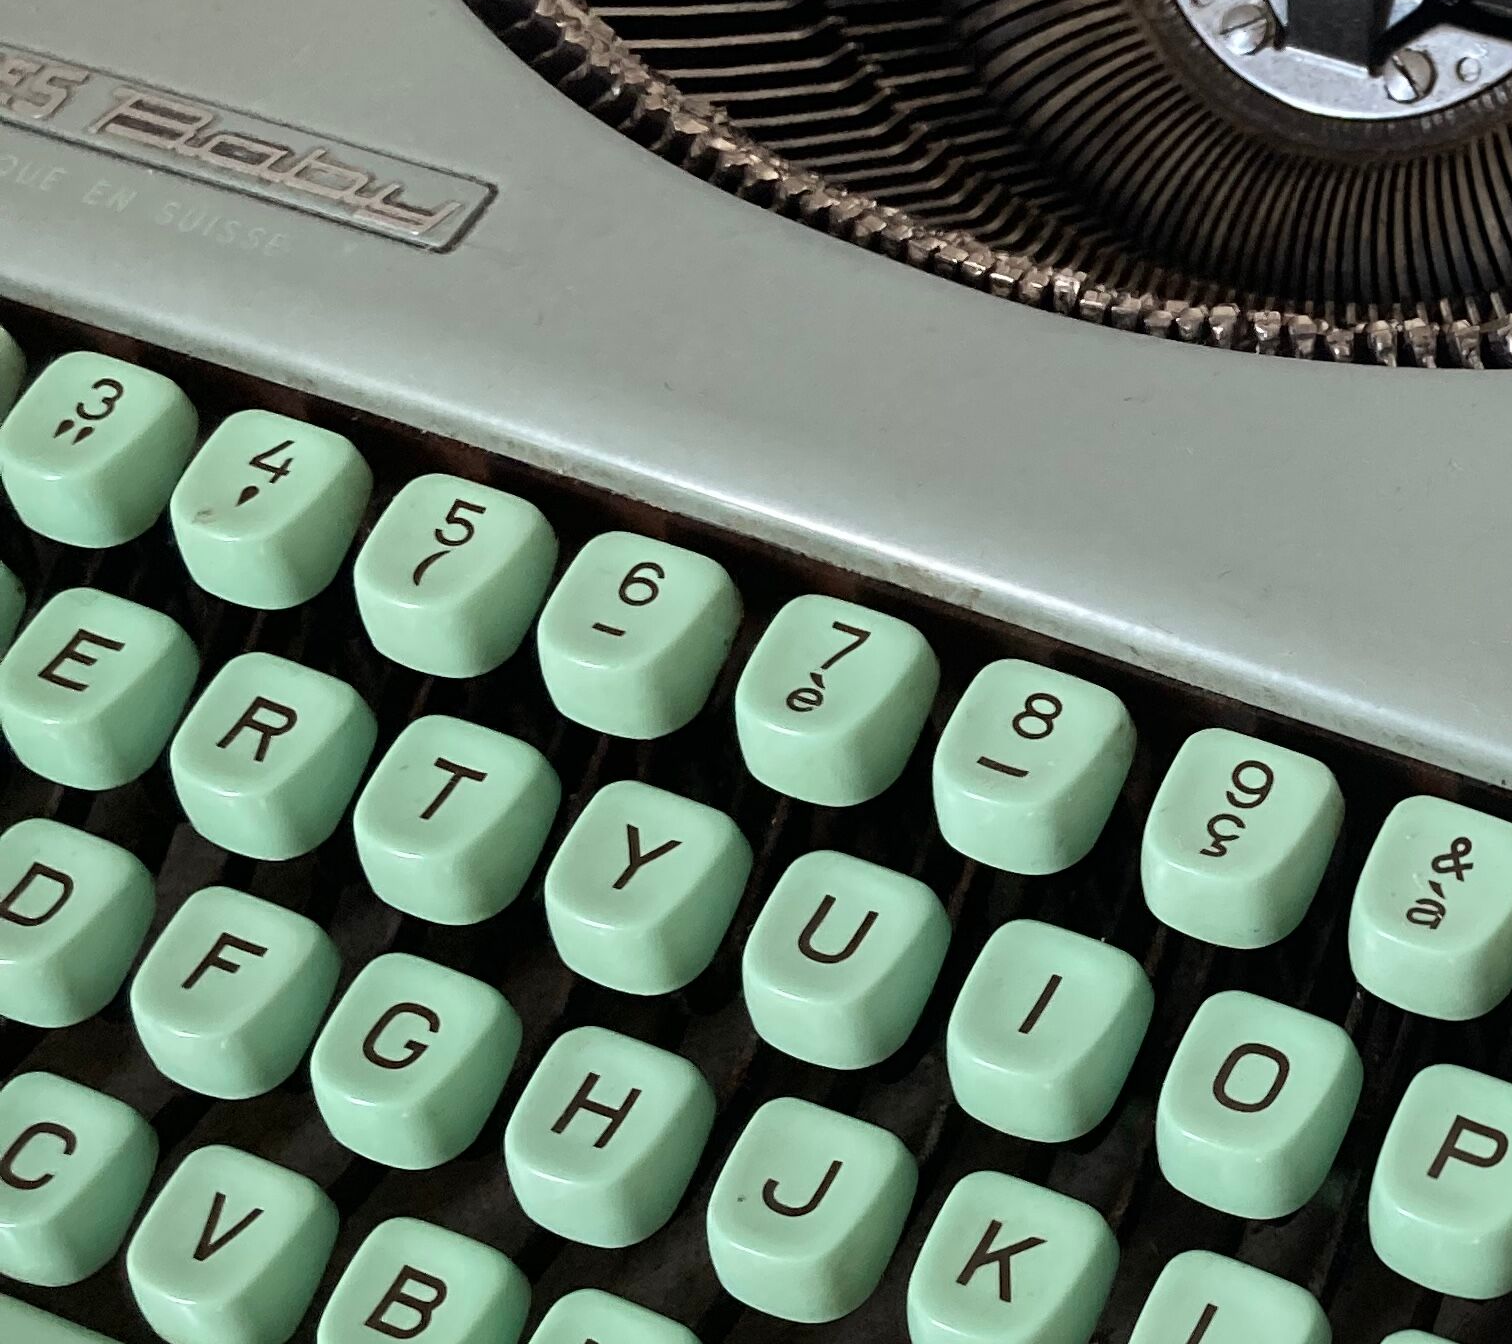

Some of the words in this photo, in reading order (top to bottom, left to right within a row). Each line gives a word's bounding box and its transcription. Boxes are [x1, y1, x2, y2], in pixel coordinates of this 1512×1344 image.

[87, 85, 464, 236] Baby
[74, 377, 125, 422] 3
[247, 439, 296, 485] 4
[433, 497, 488, 548] 5
[617, 560, 666, 608] 6
[35, 627, 127, 693] E
[819, 619, 873, 671] 7
[214, 694, 299, 764] R
[1010, 691, 1064, 741] 8
[418, 756, 489, 822] T
[1224, 758, 1276, 810] 9
[610, 822, 684, 891] Y
[1429, 835, 1475, 883] &
[0, 860, 75, 928] D
[179, 931, 270, 991] F
[796, 893, 880, 966] U
[361, 1000, 442, 1071] G
[1016, 973, 1064, 1036] I
[549, 1070, 643, 1150] H
[1211, 1041, 1291, 1114] O
[0, 1120, 78, 1192] C
[1425, 1113, 1510, 1181] P
[760, 1159, 844, 1219] J
[191, 1190, 266, 1263] V
[954, 1218, 1049, 1304] K
[362, 1263, 449, 1341] B
